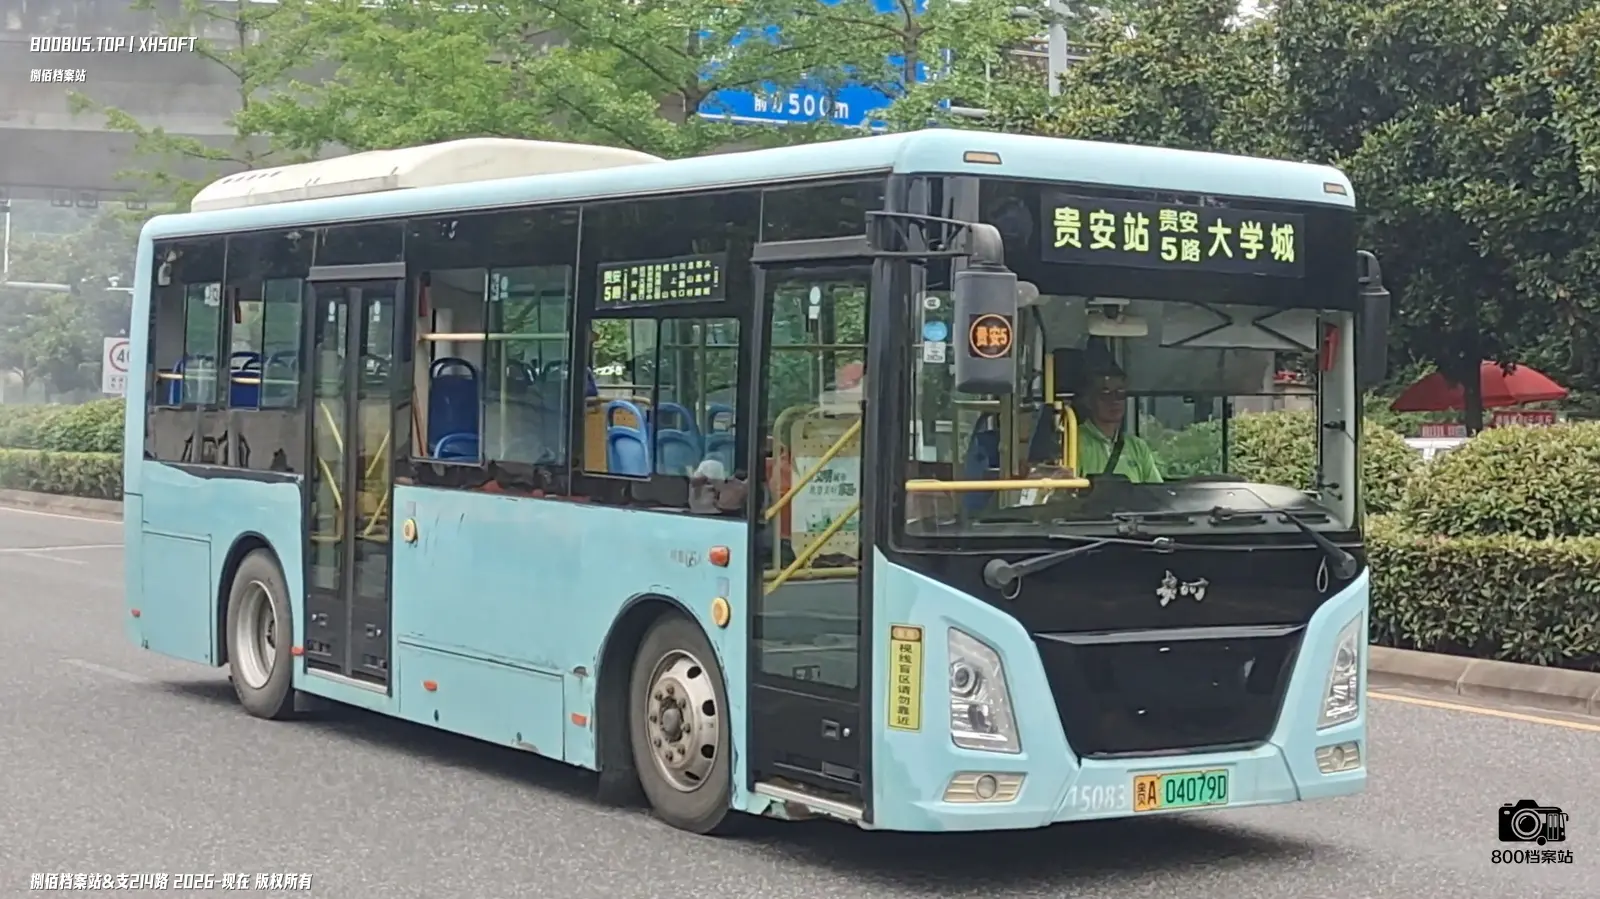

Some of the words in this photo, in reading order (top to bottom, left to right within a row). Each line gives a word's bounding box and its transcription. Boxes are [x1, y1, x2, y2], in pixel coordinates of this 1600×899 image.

[1053, 207, 1150, 252] 贵安站
[1158, 208, 1199, 234] 贵安
[1160, 236, 1201, 262] 5路
[1207, 217, 1295, 263] 大学城
[116, 348, 130, 363] 4
[896, 643, 913, 726] 视线盲区请勿靠近
[1068, 784, 1126, 811] 15083
